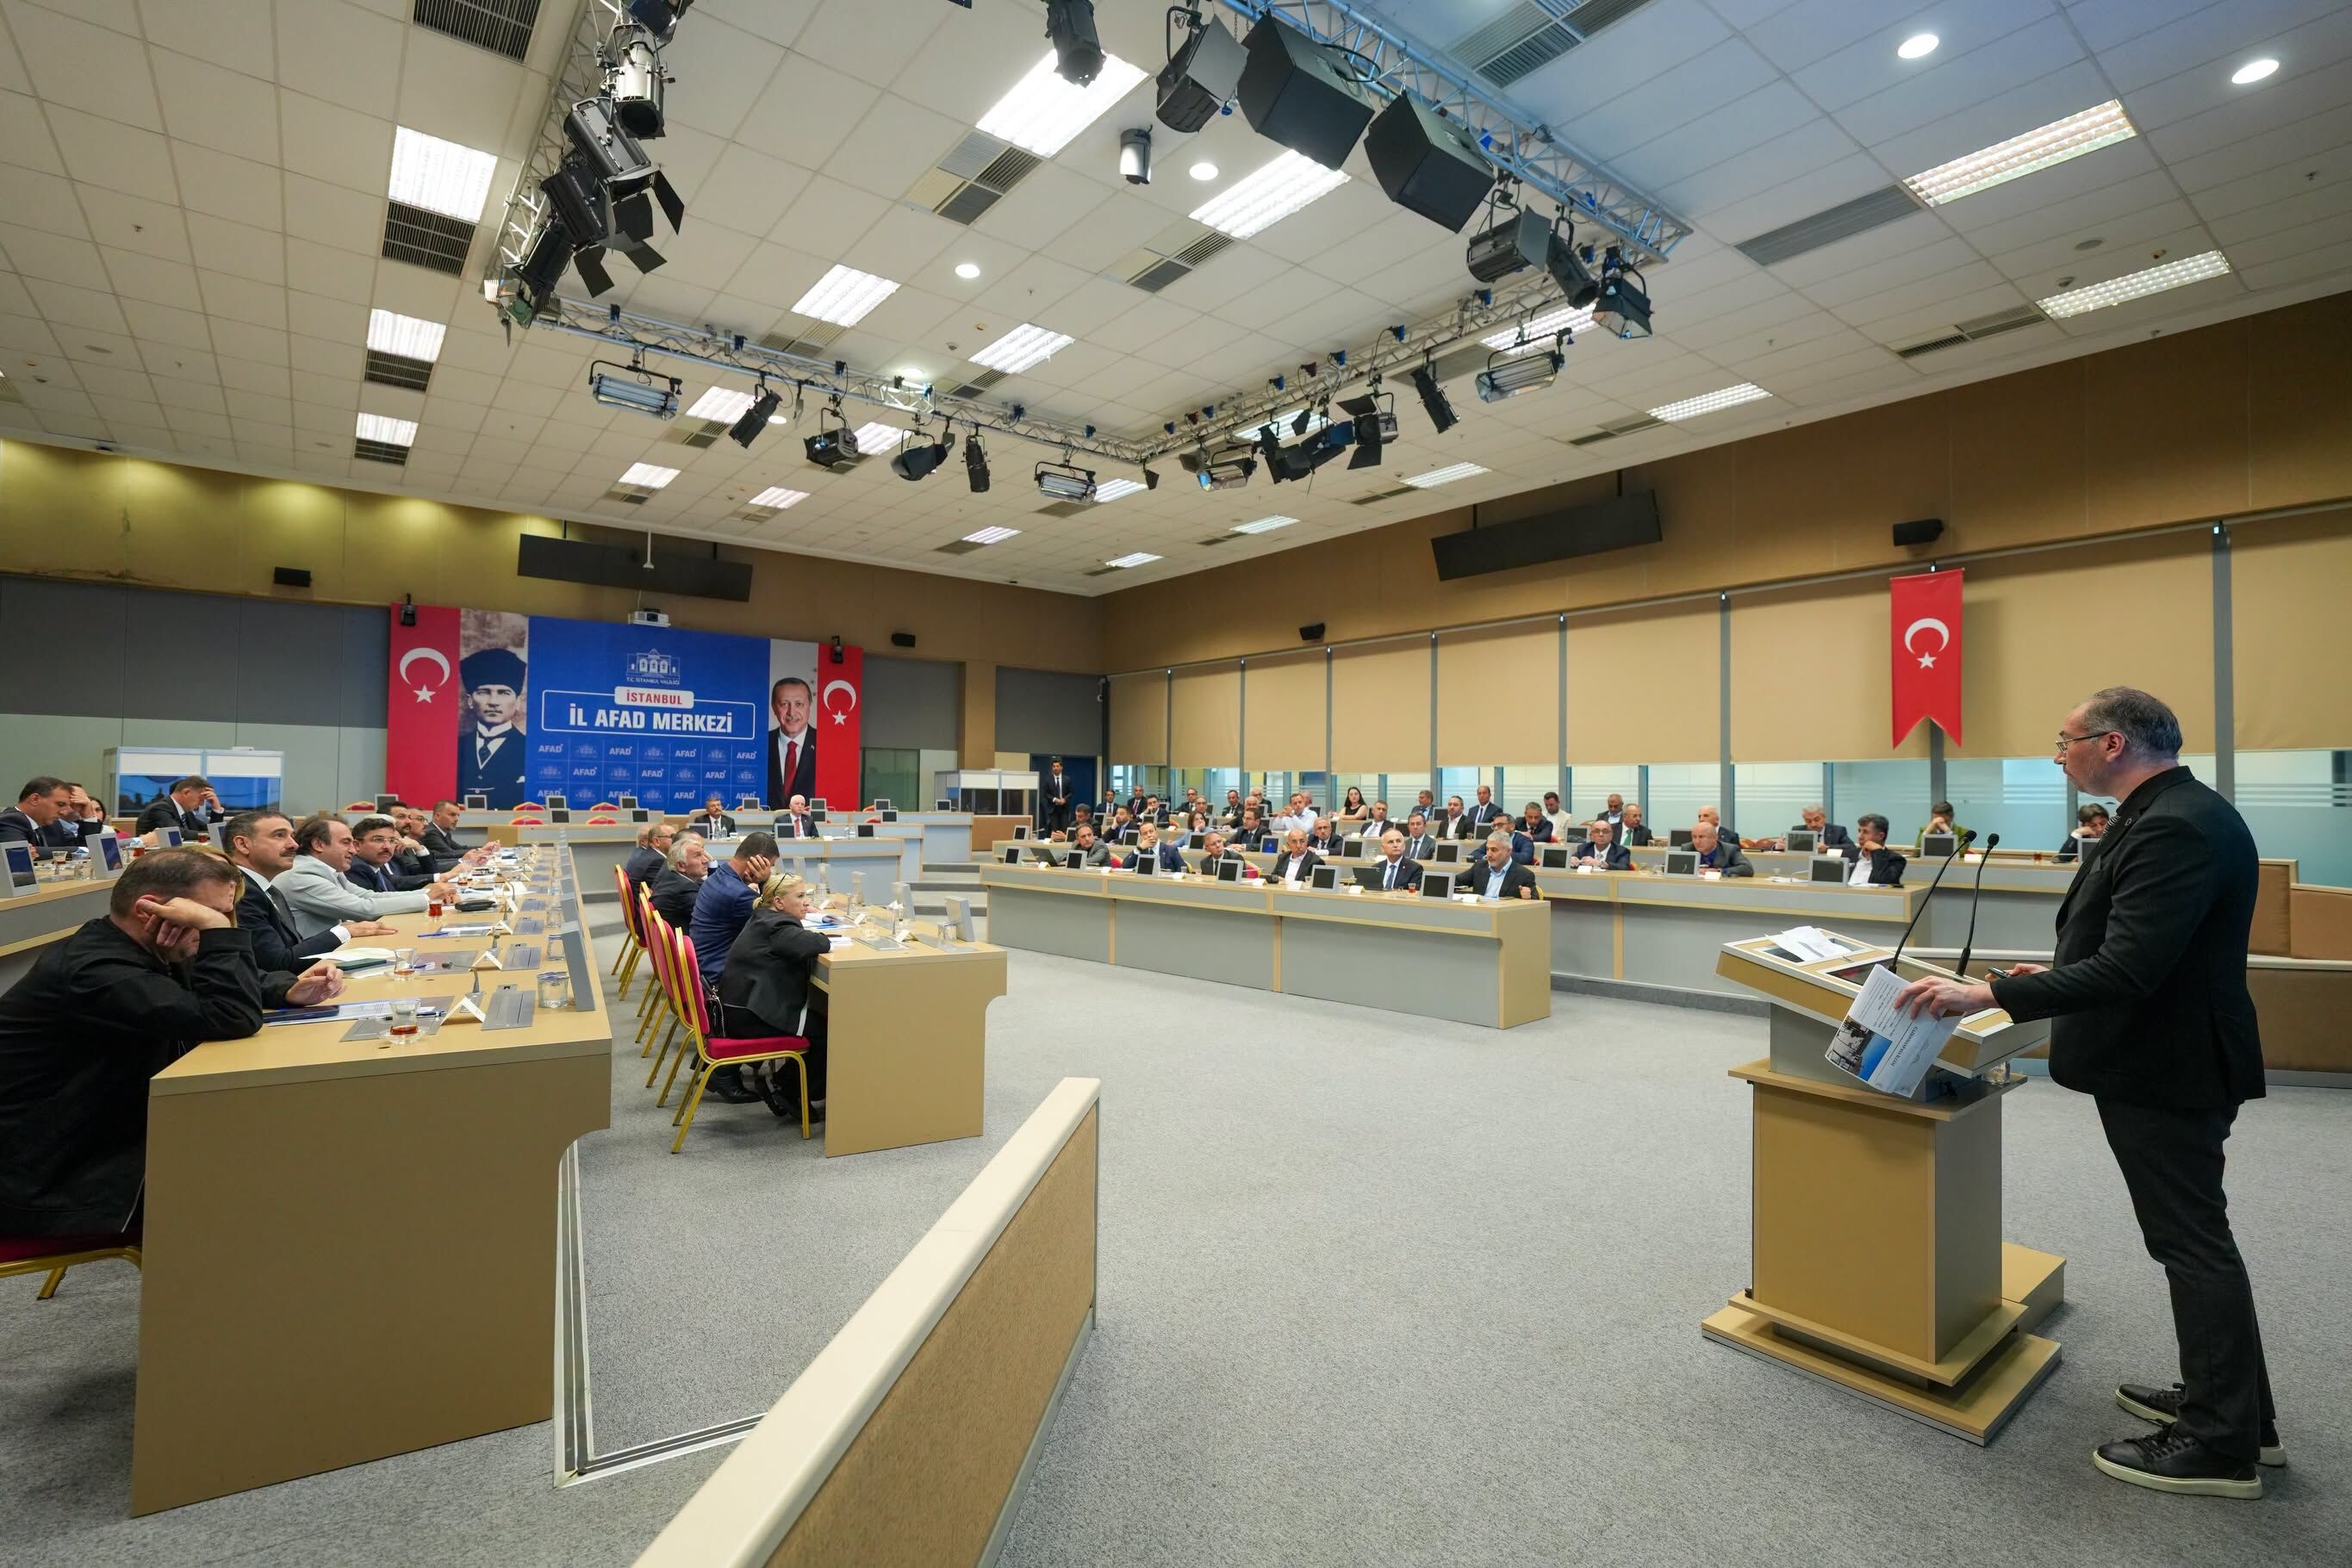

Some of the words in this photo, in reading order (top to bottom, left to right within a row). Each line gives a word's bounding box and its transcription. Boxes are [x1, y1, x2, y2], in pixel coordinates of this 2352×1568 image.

[626, 689, 682, 705] İSTANBUL
[569, 703, 588, 726] İL
[594, 710, 645, 729] AFAD
[652, 712, 732, 733] MERKEZİ
[538, 744, 563, 753] AFAD
[609, 747, 632, 756] AFAD
[675, 750, 696, 758] AFAD
[573, 768, 596, 776] AFAD
[641, 769, 663, 778] AFAD
[674, 791, 695, 800] AFAD
